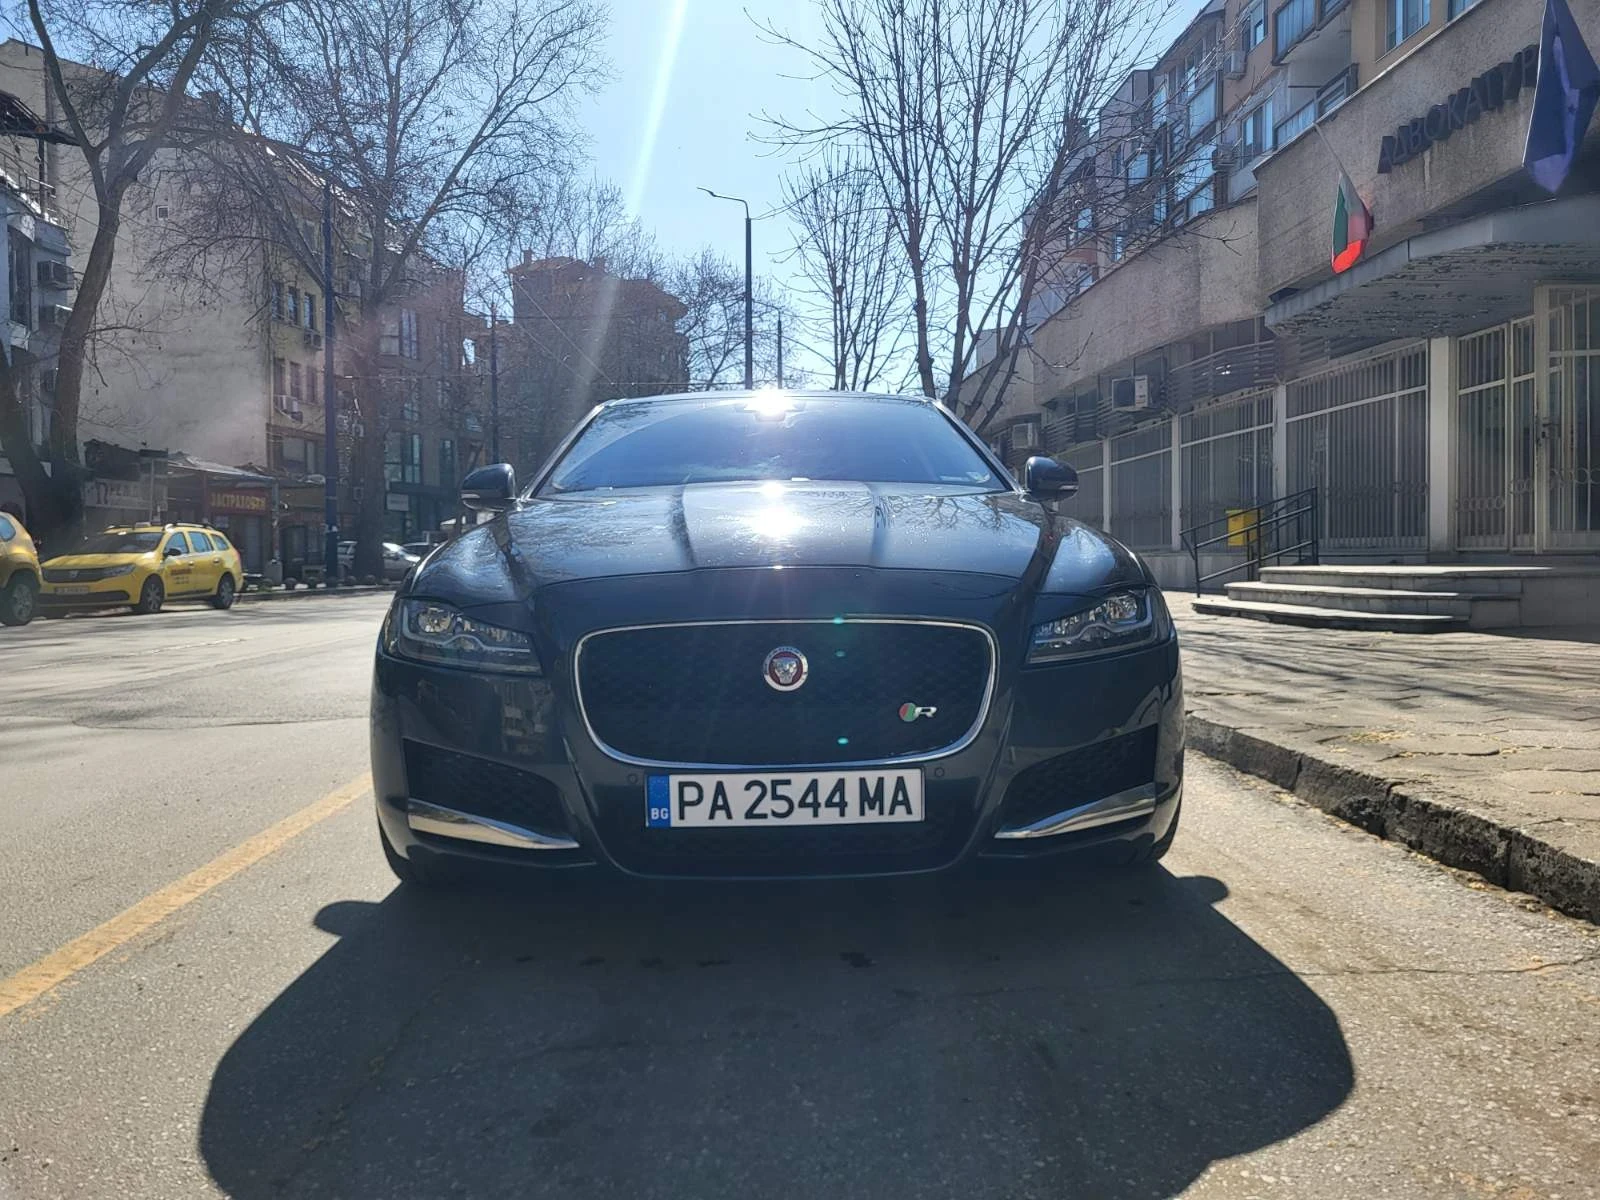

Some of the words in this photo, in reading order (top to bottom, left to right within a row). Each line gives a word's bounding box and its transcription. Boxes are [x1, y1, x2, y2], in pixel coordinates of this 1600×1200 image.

[678, 780, 733, 820] PA
[744, 778, 848, 820] 2544
[859, 776, 913, 817] MA
[651, 808, 669, 820] BG
